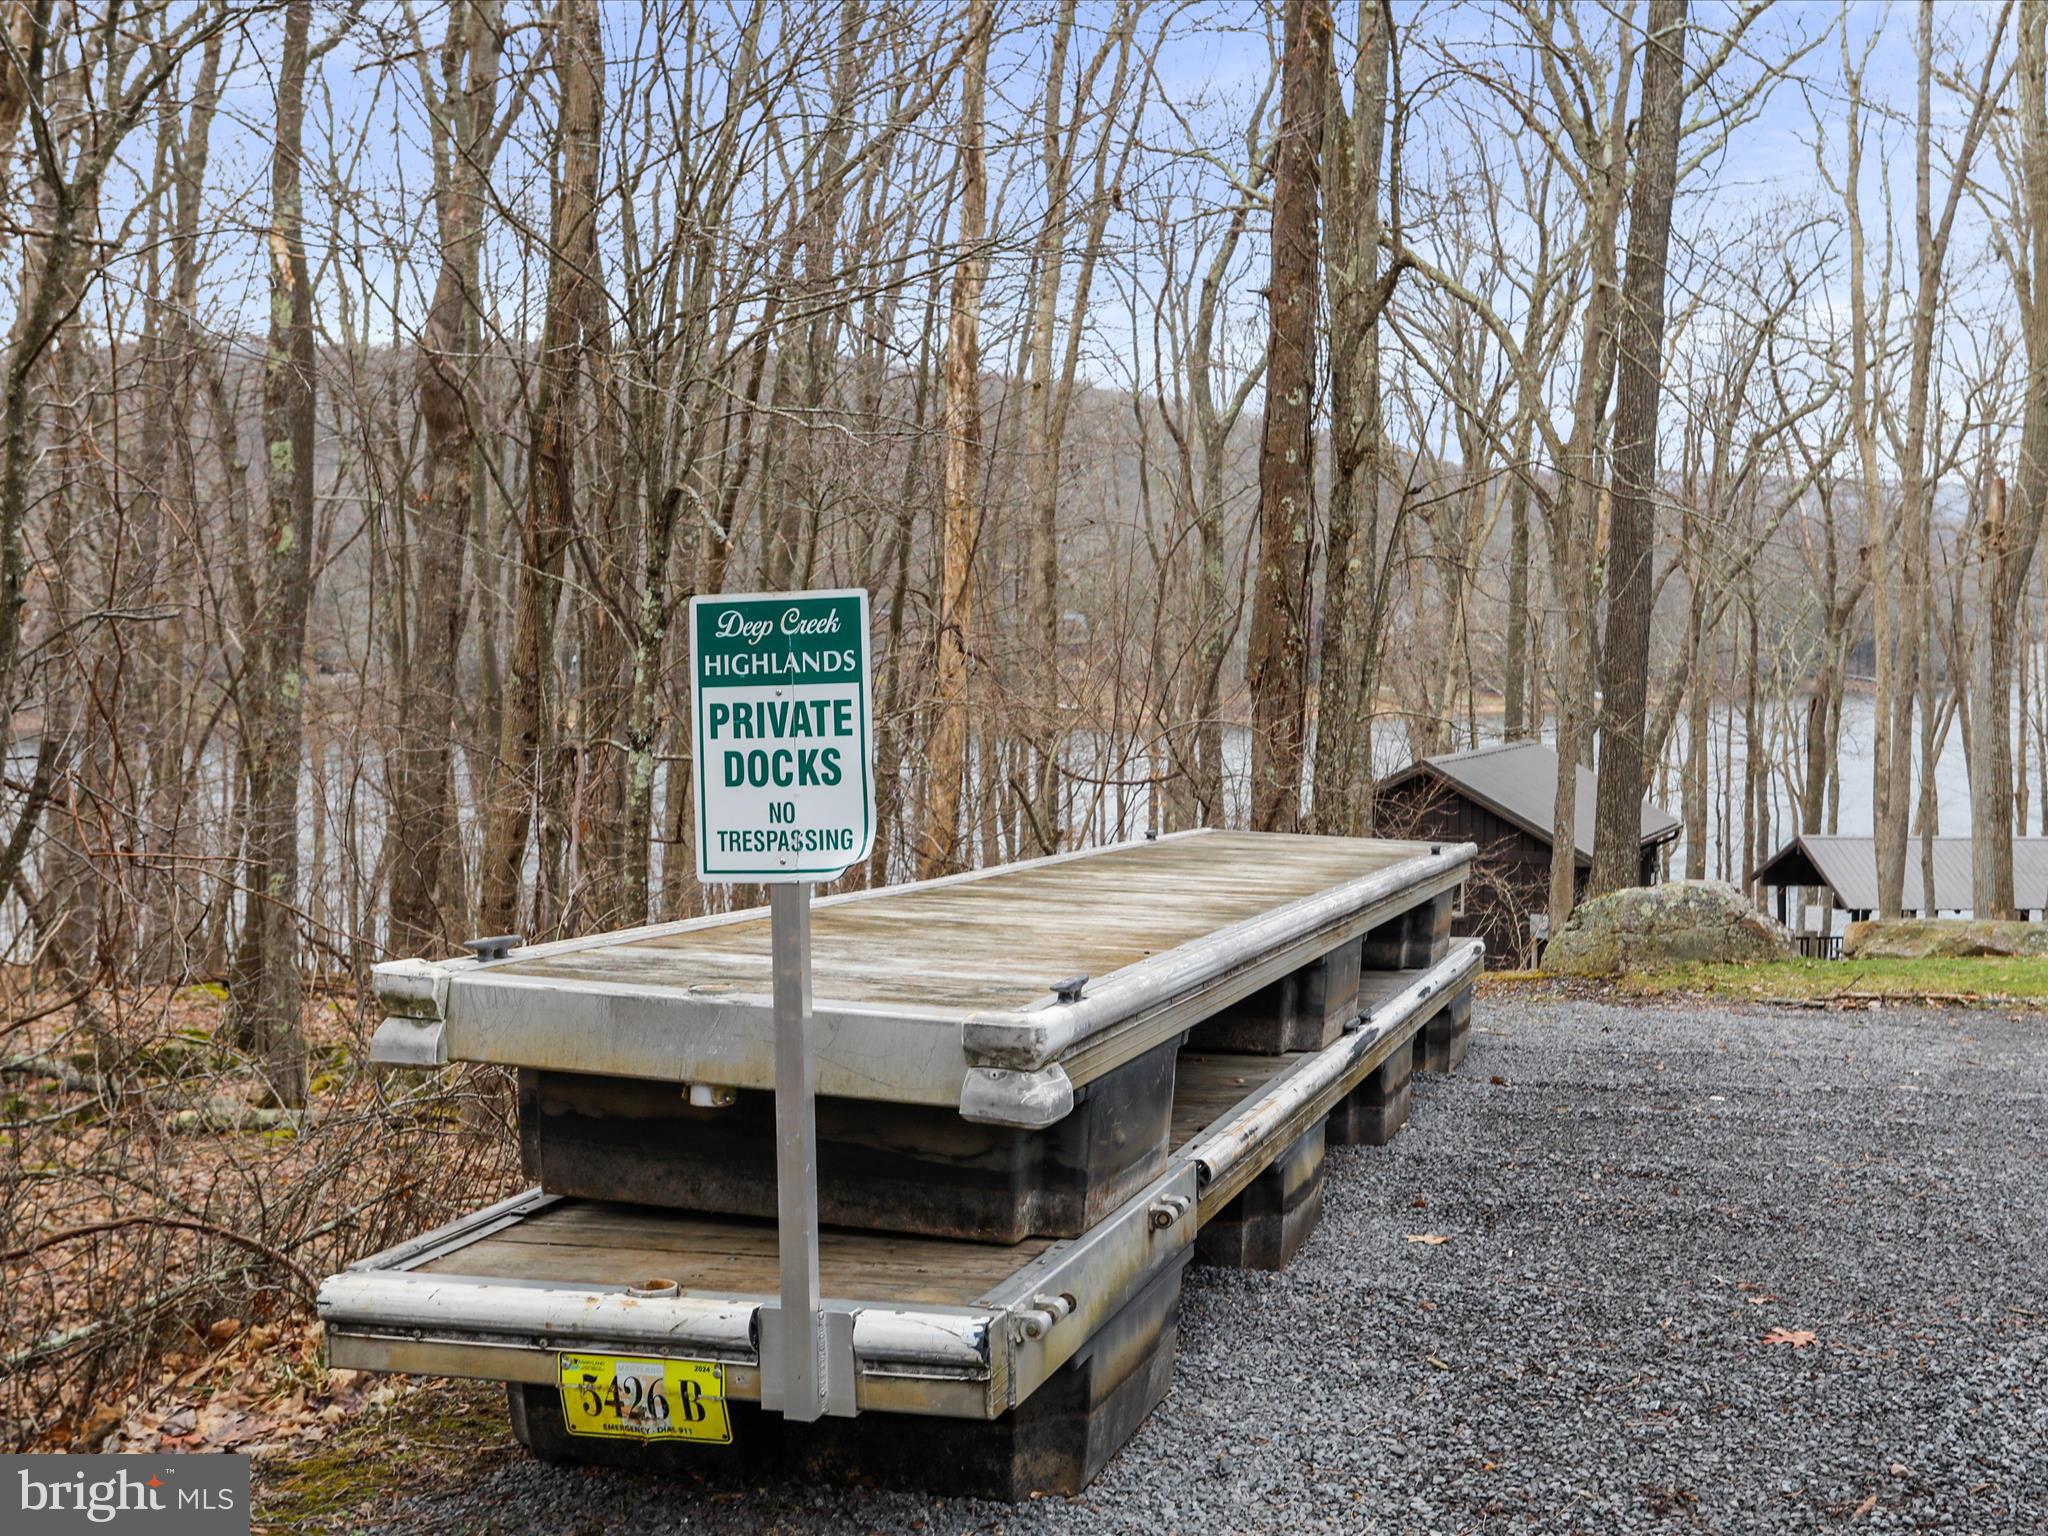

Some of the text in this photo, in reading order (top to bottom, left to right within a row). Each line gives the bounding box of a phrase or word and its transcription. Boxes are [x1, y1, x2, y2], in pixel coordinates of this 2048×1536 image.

[715, 607, 842, 646] Deep Creek
[704, 649, 857, 677] HIGHLANDS
[708, 699, 854, 740] PRIVATE
[723, 747, 842, 788] DOCKS
[768, 801, 796, 825] NO
[716, 828, 854, 853] TRESPASSING
[694, 1365, 711, 1374] 2024
[581, 1373, 706, 1422] 5426 B
[602, 1423, 650, 1435] EMERGENCY
[656, 1425, 678, 1435] DIAL
[678, 1426, 693, 1435] 911
